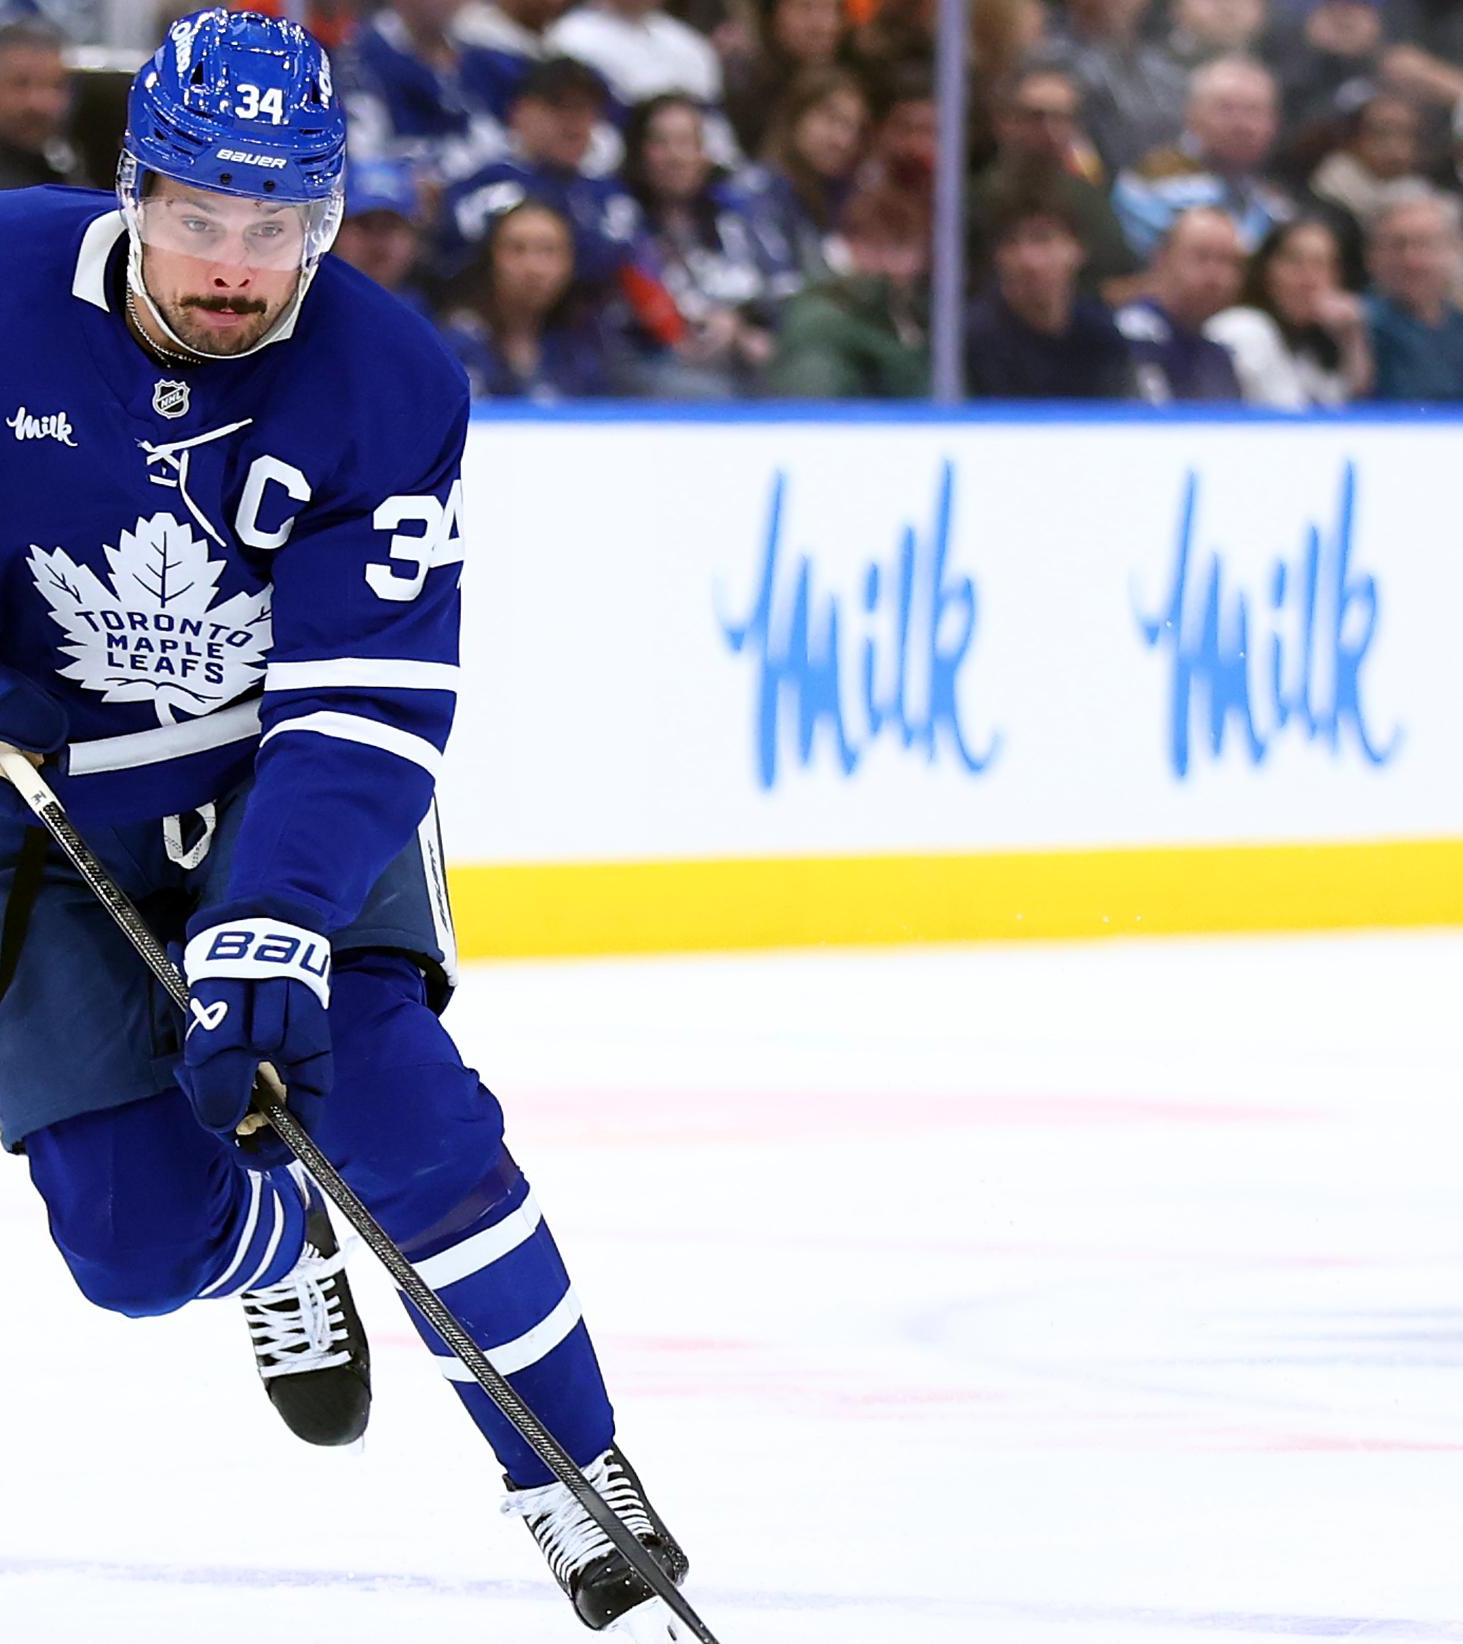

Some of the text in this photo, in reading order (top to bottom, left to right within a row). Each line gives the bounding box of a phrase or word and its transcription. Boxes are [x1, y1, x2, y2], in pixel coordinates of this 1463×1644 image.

[235, 83, 283, 125] 34
[159, 391, 183, 409] NHL
[6, 406, 78, 447] Milk
[235, 454, 312, 549] C
[365, 479, 465, 602] 34
[74, 610, 254, 648] TORONTO
[714, 456, 1004, 794] Milk
[1131, 456, 1404, 780] Milk
[107, 632, 224, 660] MAPLE
[107, 651, 224, 684] LEAFS
